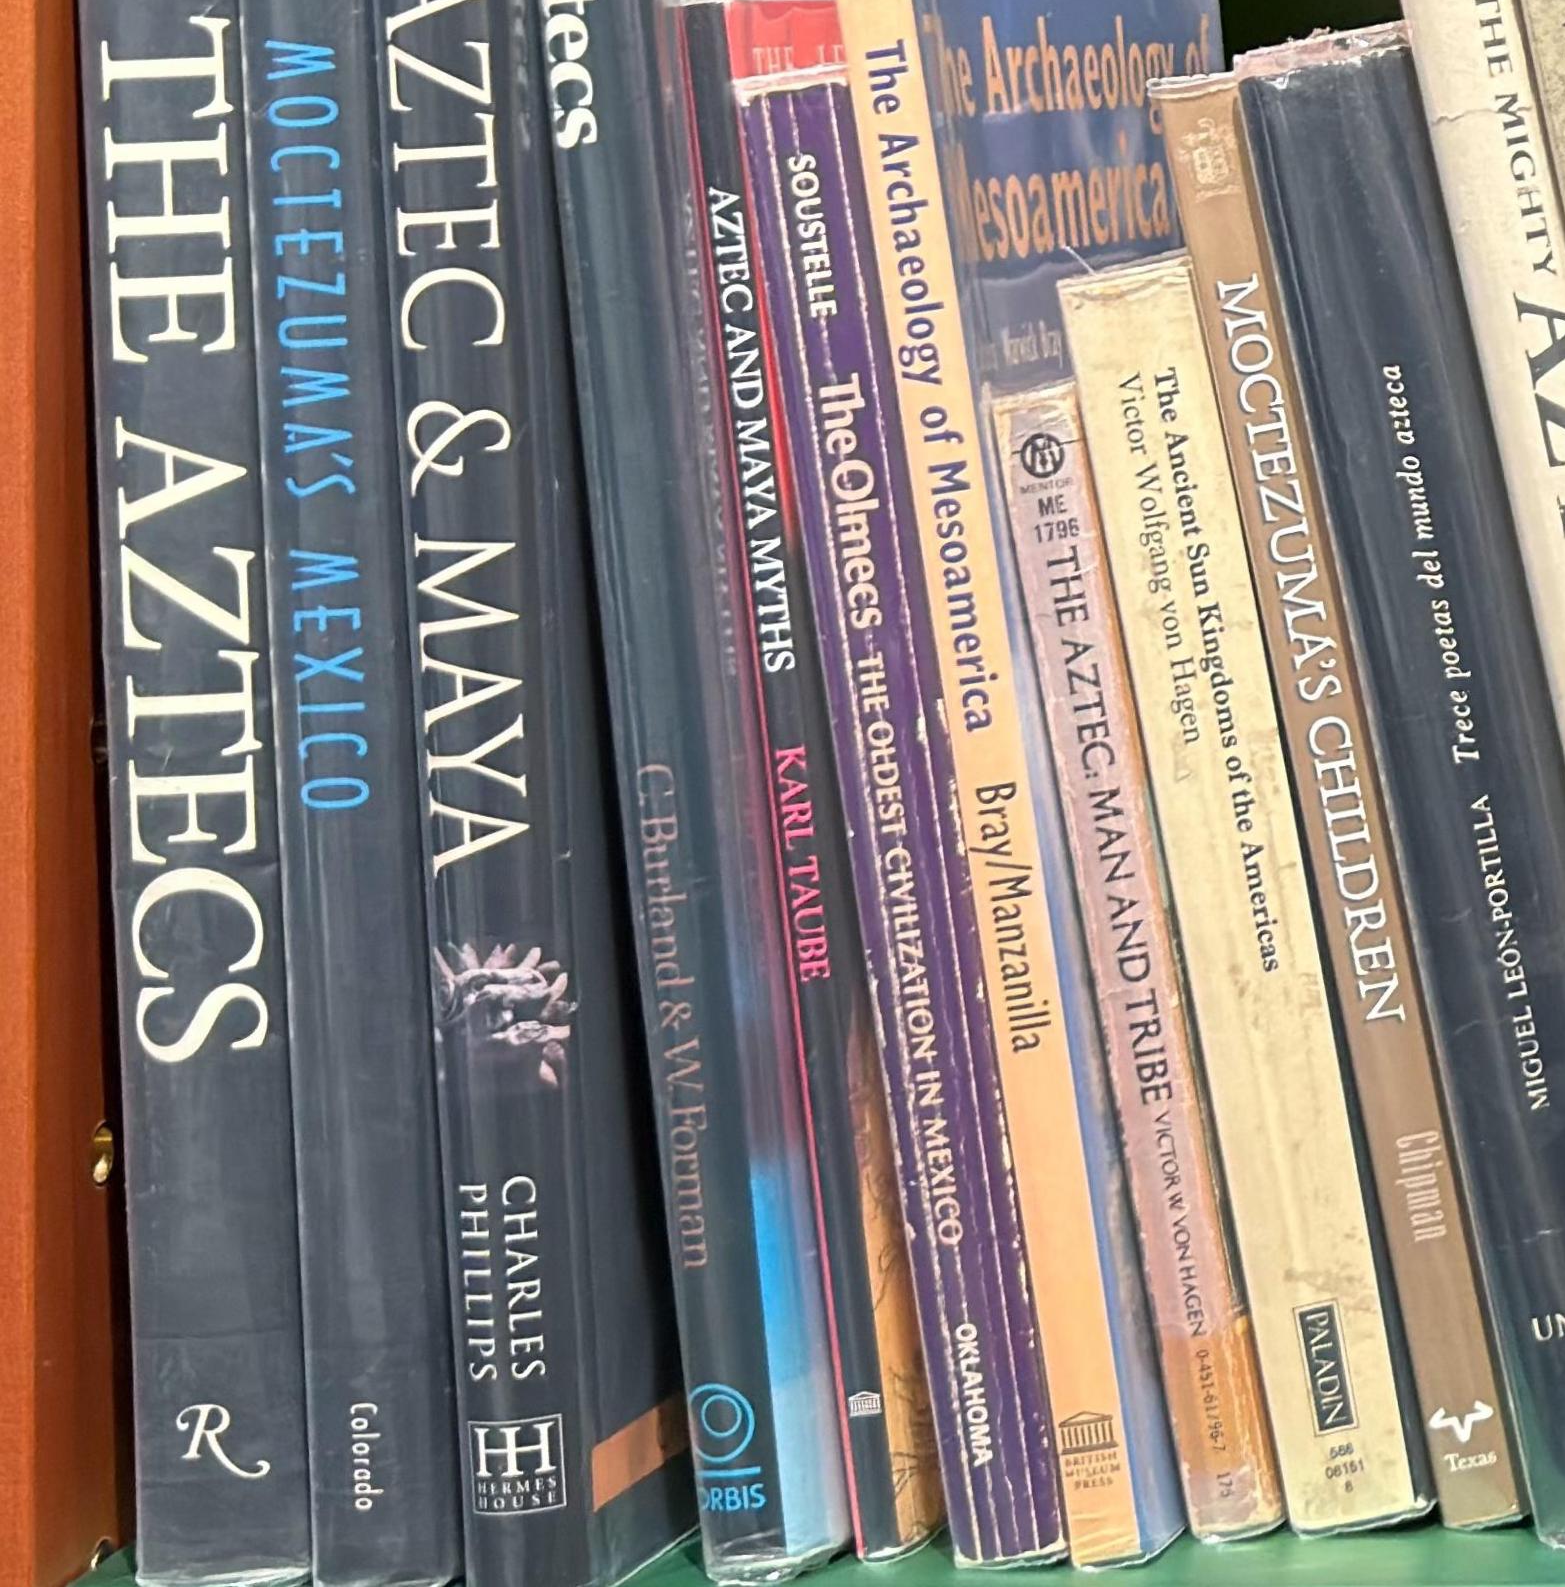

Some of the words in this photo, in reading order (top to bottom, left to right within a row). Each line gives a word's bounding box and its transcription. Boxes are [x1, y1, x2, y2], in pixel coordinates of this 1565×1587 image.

[863, 38, 907, 117] The
[101, 14, 236, 363] THE
[1494, 92, 1560, 277] MIGHTY
[265, 39, 357, 500] MOCTEZUMA'S
[707, 187, 755, 314] AZTEC
[879, 130, 946, 387] Archaeology
[725, 324, 765, 410] AND
[1117, 370, 1148, 457] Victor
[1382, 363, 1416, 446] azteca
[406, 400, 512, 497] &
[734, 416, 779, 533] MAYA
[919, 405, 965, 447] of
[1018, 476, 1075, 496] MENTOR
[1033, 516, 1081, 544] 1796
[1037, 493, 1068, 518] ME
[1133, 461, 1173, 593] Wolfgang
[1395, 454, 1435, 541] mundo
[749, 536, 796, 674] MYTHS
[929, 460, 1000, 733] Mesoamerica
[1160, 597, 1185, 652] von
[1411, 550, 1445, 591] del
[290, 548, 370, 811] MEXICO
[1216, 271, 1344, 703] MOCTEZUMA'S
[1308, 715, 1407, 1023] CHILDREN
[1431, 598, 1472, 679] poetas
[116, 416, 269, 1064] AZTECS
[413, 532, 530, 877] MAYA
[1169, 653, 1201, 746] Hagen
[1450, 687, 1481, 766] Trece
[775, 745, 816, 853] KARL
[787, 855, 832, 984] TAUBE
[1394, 1128, 1448, 1245] Chipman
[459, 1183, 497, 1382] PHILLIPS
[500, 1175, 546, 1381] CHARLES
[954, 1322, 994, 1468] OKLAHOMA
[1304, 1311, 1348, 1426] PALADIN
[349, 1402, 381, 1512] Colorado
[477, 1474, 559, 1495] HERMES
[477, 1490, 559, 1511] HOUSE
[1444, 1448, 1498, 1473] Texas
